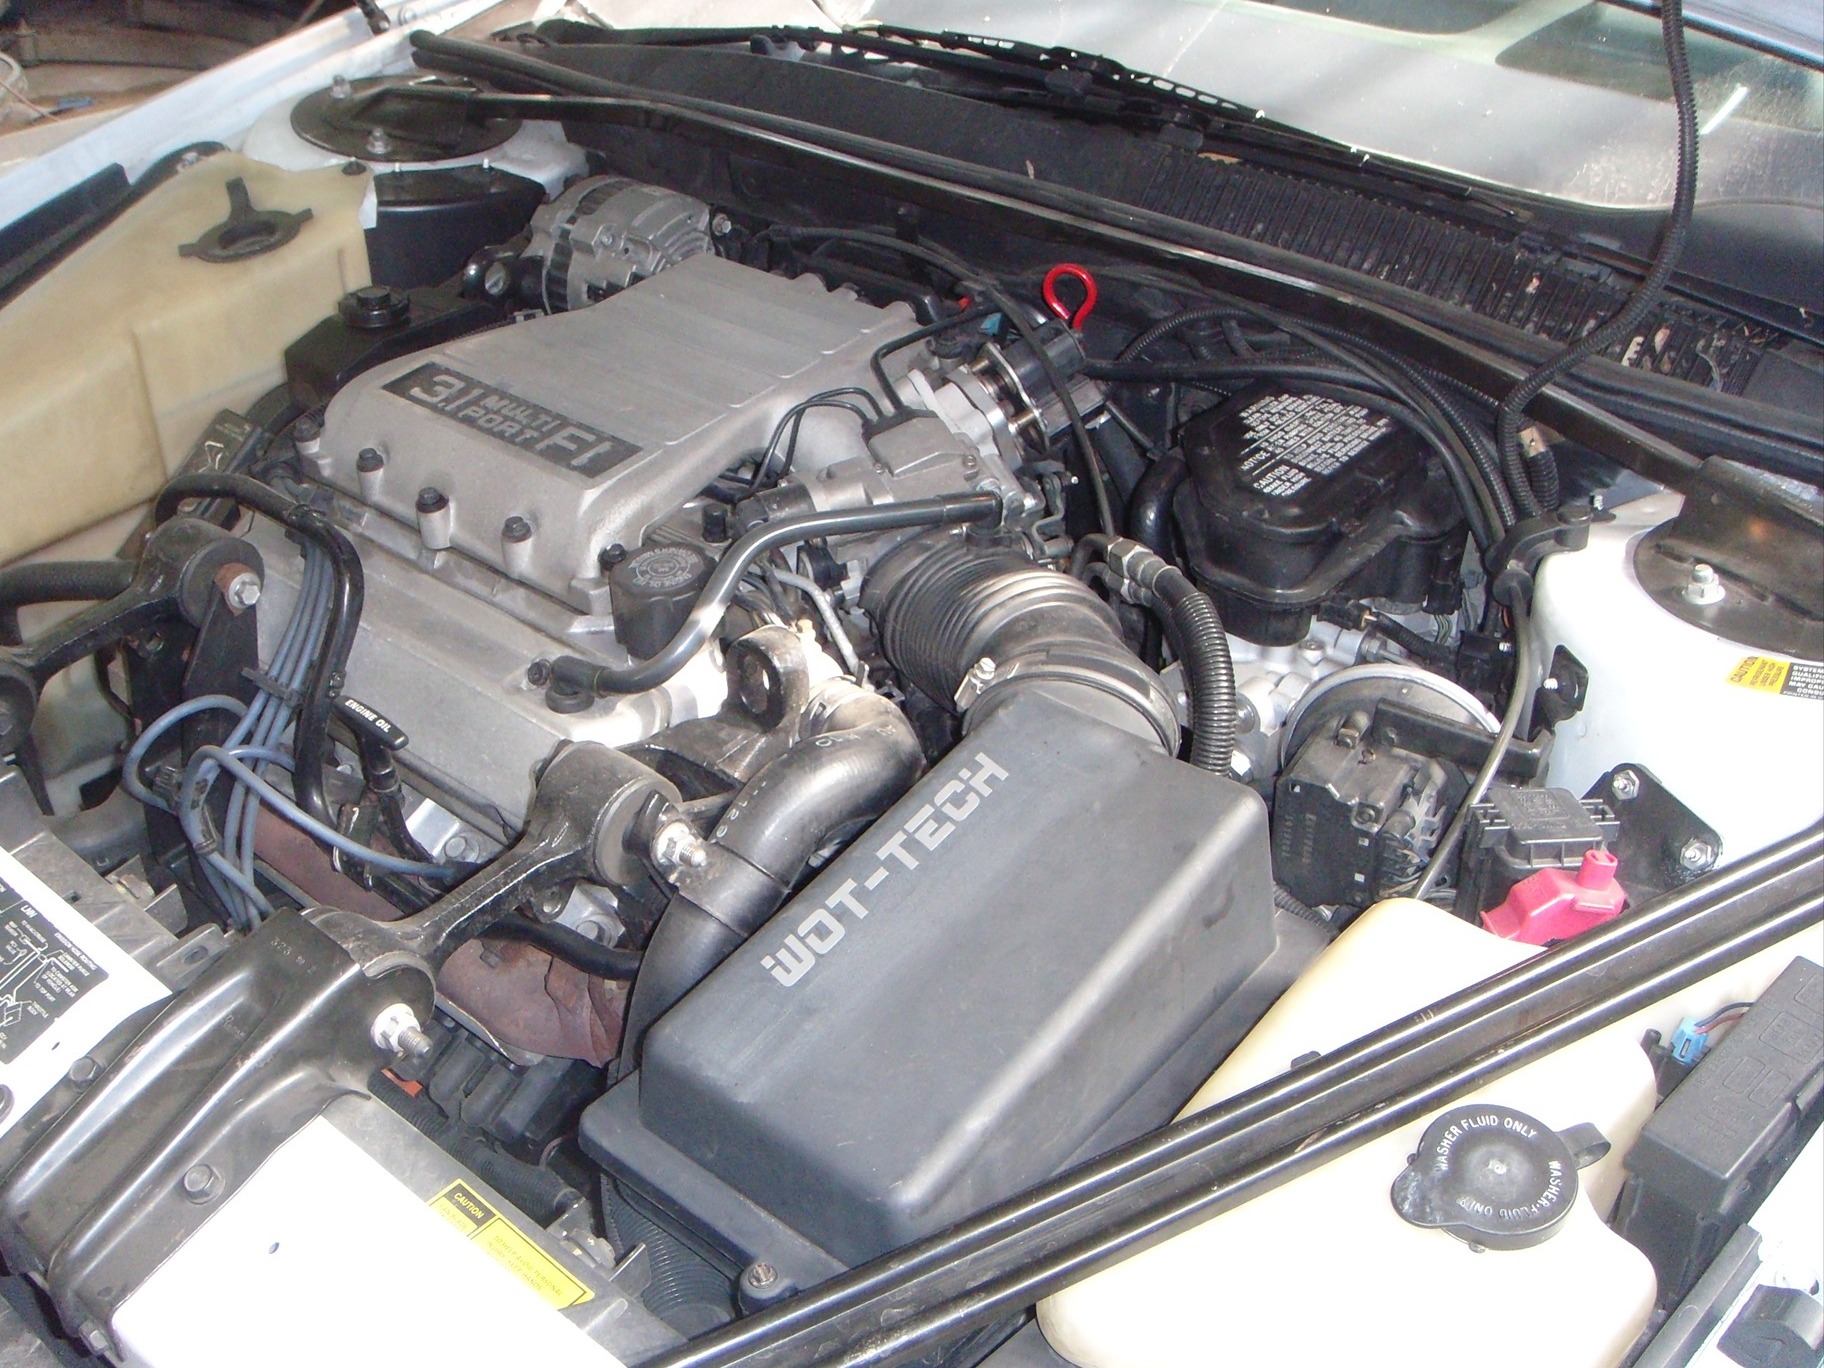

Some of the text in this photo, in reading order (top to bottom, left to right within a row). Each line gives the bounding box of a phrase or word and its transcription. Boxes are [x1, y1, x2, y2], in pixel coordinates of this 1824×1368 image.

[458, 406, 540, 443] PORT
[479, 394, 561, 432] MULTI
[535, 426, 612, 467] FI
[1238, 450, 1270, 470] NOTICE
[1253, 465, 1290, 488] CAUTION
[1730, 656, 1759, 683] CAUTION
[344, 699, 392, 733] ENGINE OIL
[759, 752, 1010, 988] WOT-TECH
[1435, 1115, 1538, 1173] WASHER FLUID ONLY
[453, 1192, 485, 1220] CAUTION
